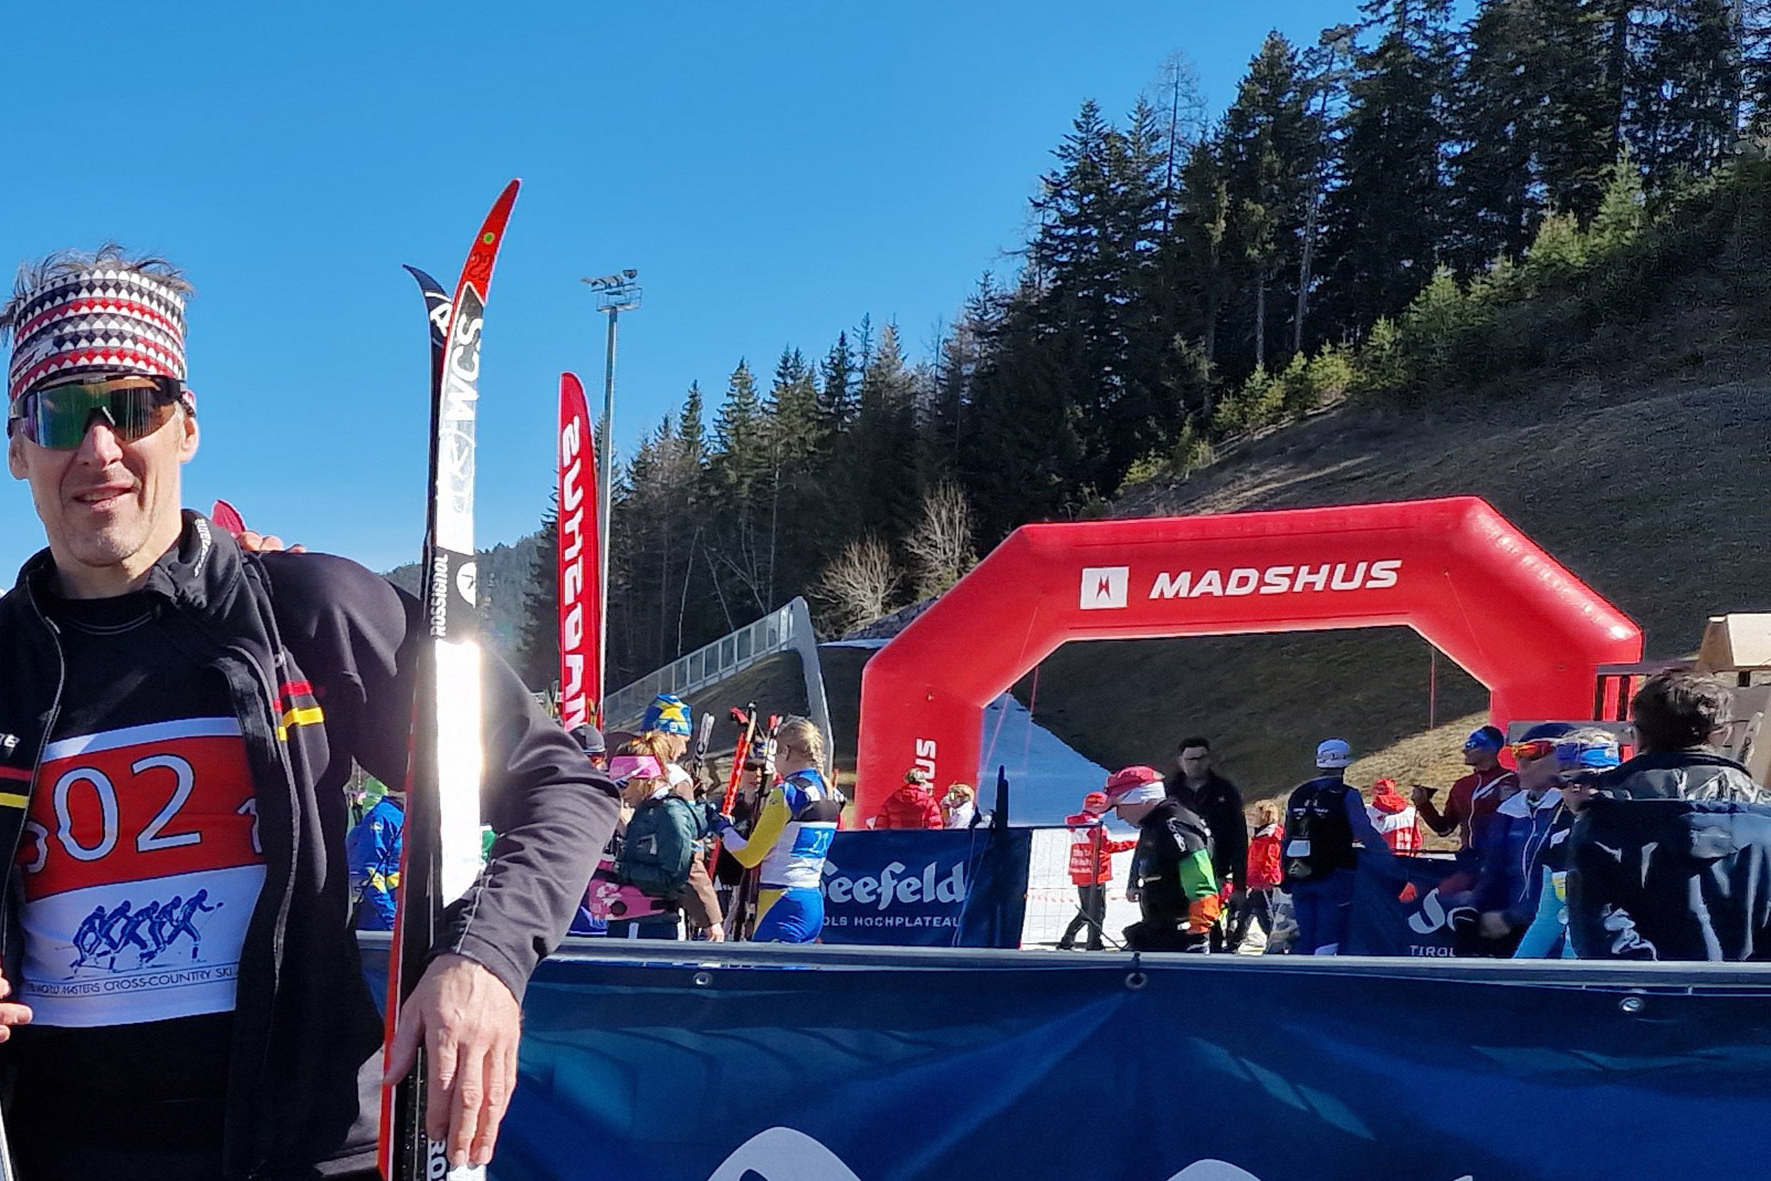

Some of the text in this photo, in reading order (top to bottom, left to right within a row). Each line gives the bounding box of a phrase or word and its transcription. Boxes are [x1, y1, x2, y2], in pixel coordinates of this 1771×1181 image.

[430, 554, 448, 638] ROSSIGNOL
[1149, 560, 1401, 600] MADSHUS
[236, 798, 264, 854] 1
[854, 915, 962, 928] HOCHPLATEAU
[1410, 945, 1456, 958] TIROL
[103, 969, 211, 992] CROSS-COUNTRY
[215, 967, 233, 978] SKI
